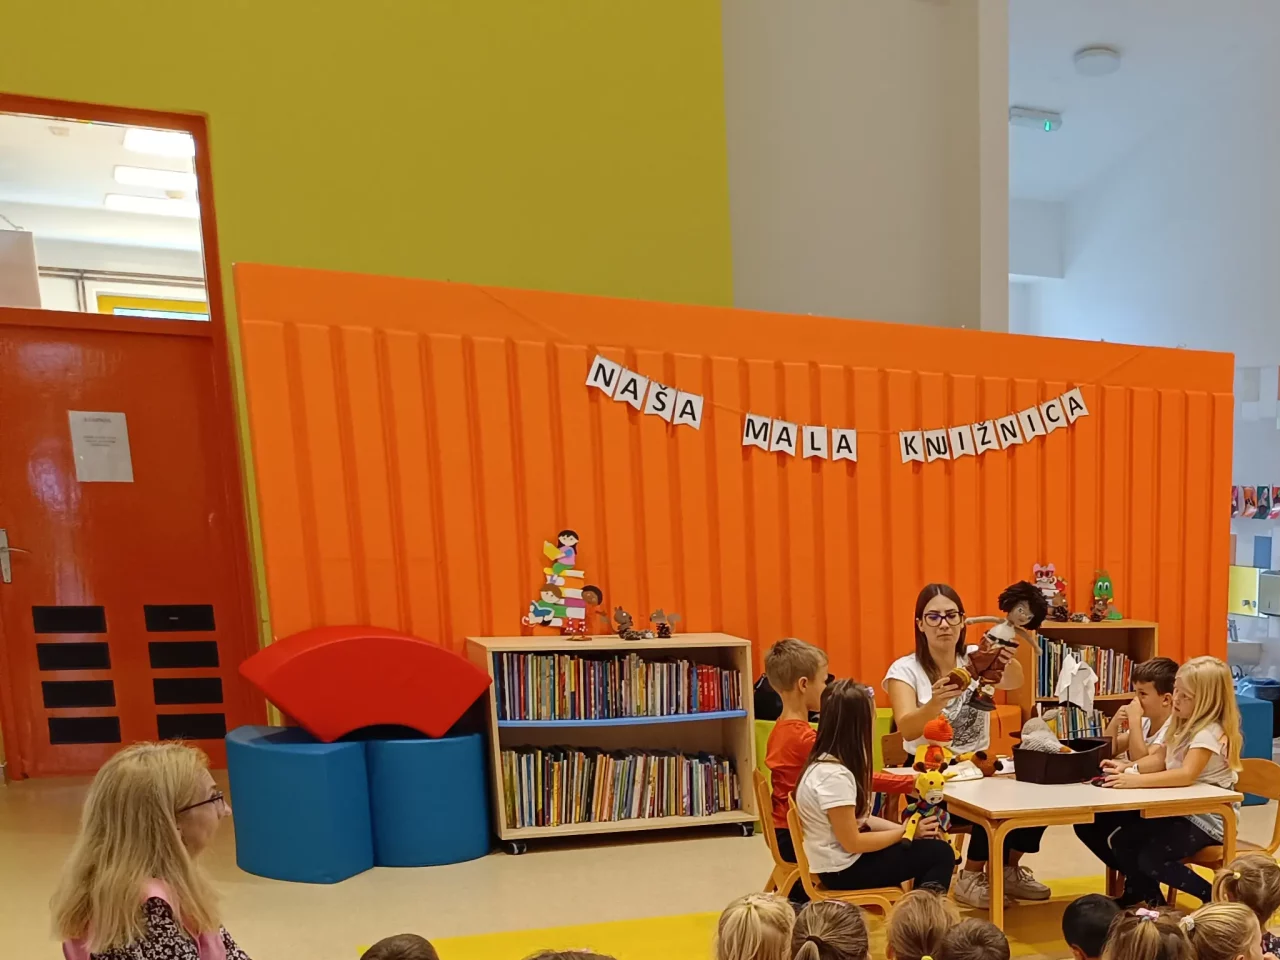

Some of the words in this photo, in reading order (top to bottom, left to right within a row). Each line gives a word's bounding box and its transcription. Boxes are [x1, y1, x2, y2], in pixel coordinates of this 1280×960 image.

[593, 362, 697, 424] NAŠA
[745, 419, 853, 454] MALA
[904, 396, 1084, 457] KNJIŽNICA
